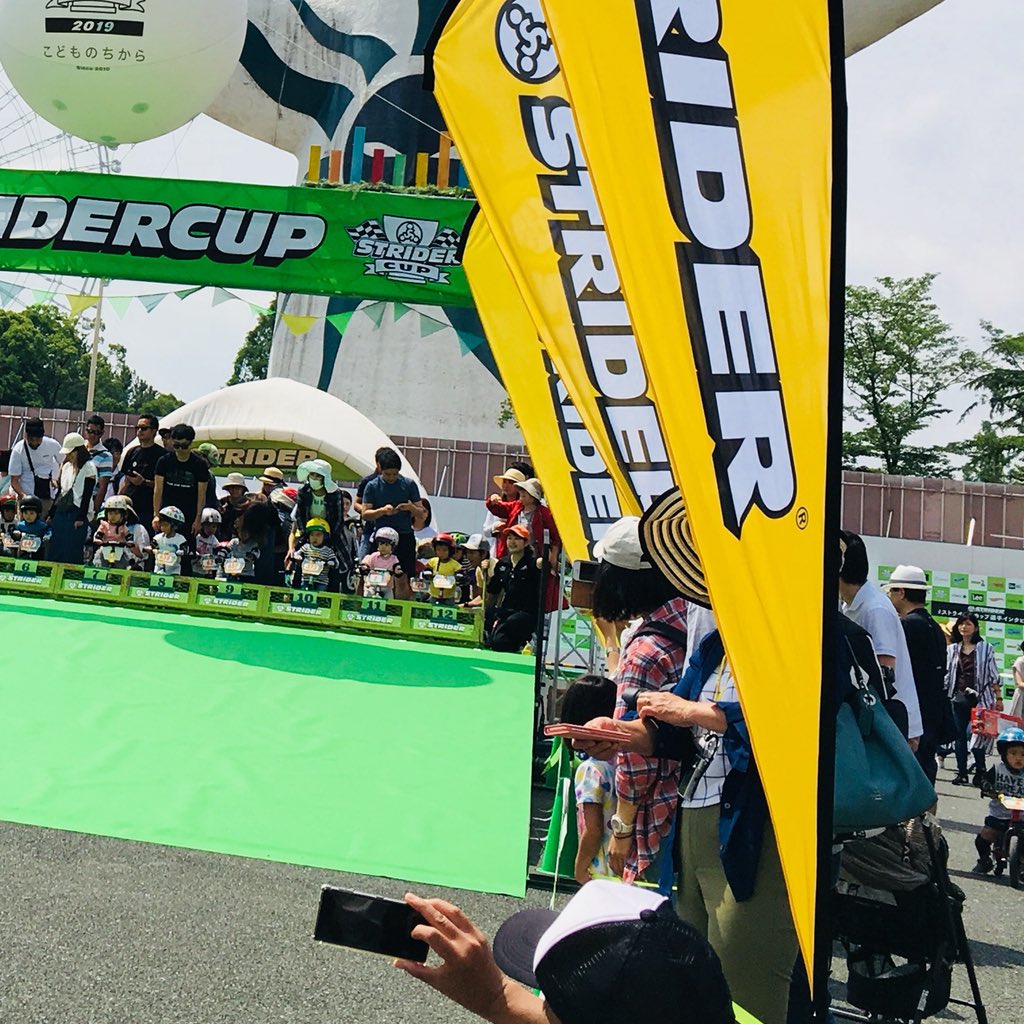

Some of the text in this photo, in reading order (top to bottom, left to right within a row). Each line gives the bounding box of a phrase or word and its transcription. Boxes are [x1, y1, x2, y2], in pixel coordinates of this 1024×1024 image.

[71, 20, 114, 32] 2019
[43, 45, 145, 62] こどものちから
[383, 262, 431, 274] CUP
[218, 449, 318, 466] TRIDER
[8, 575, 42, 584] STRIDER
[77, 583, 112, 592] STRIDER
[145, 590, 180, 600] STRIDER
[972, 593, 983, 601] Lee
[213, 598, 249, 607] STRIDER
[286, 606, 323, 616] STRIDER
[355, 614, 393, 624] STRIDER
[427, 622, 465, 632] STRIDER
